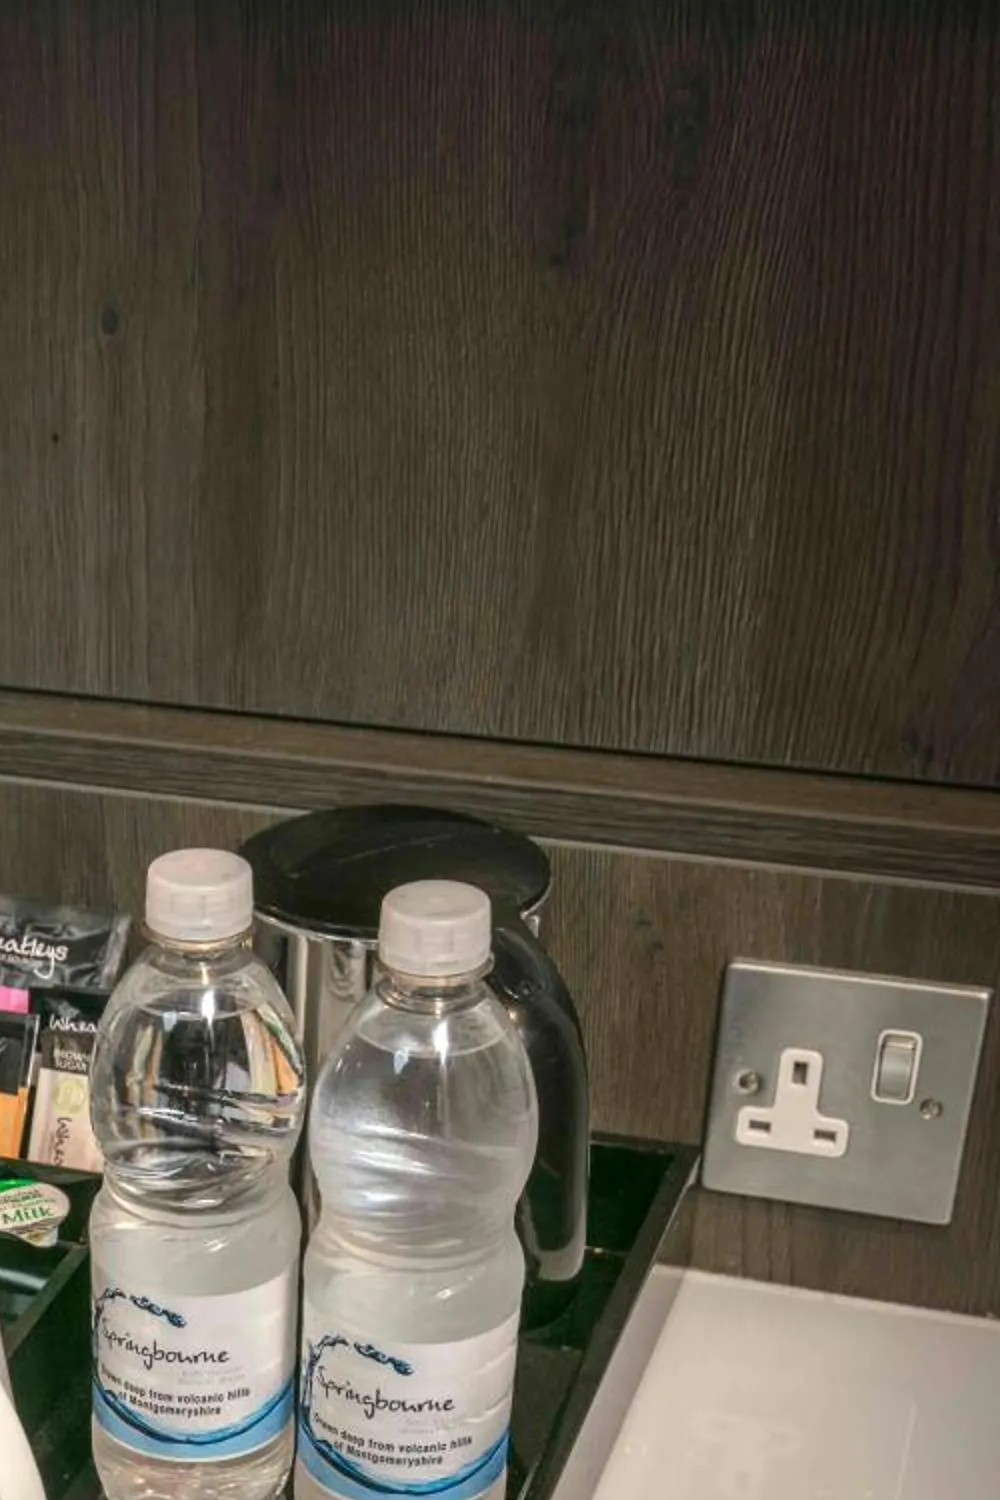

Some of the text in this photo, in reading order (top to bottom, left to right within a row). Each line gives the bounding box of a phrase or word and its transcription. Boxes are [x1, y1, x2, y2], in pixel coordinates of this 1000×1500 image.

[2, 1207, 54, 1224] Milk
[102, 1317, 231, 1370] Springbourne
[149, 1389, 174, 1402] from
[177, 1391, 224, 1405] volcanic
[228, 1387, 251, 1400] hills
[315, 1365, 456, 1420] Springbourne
[368, 1438, 395, 1451] from
[399, 1441, 447, 1454] volcanic
